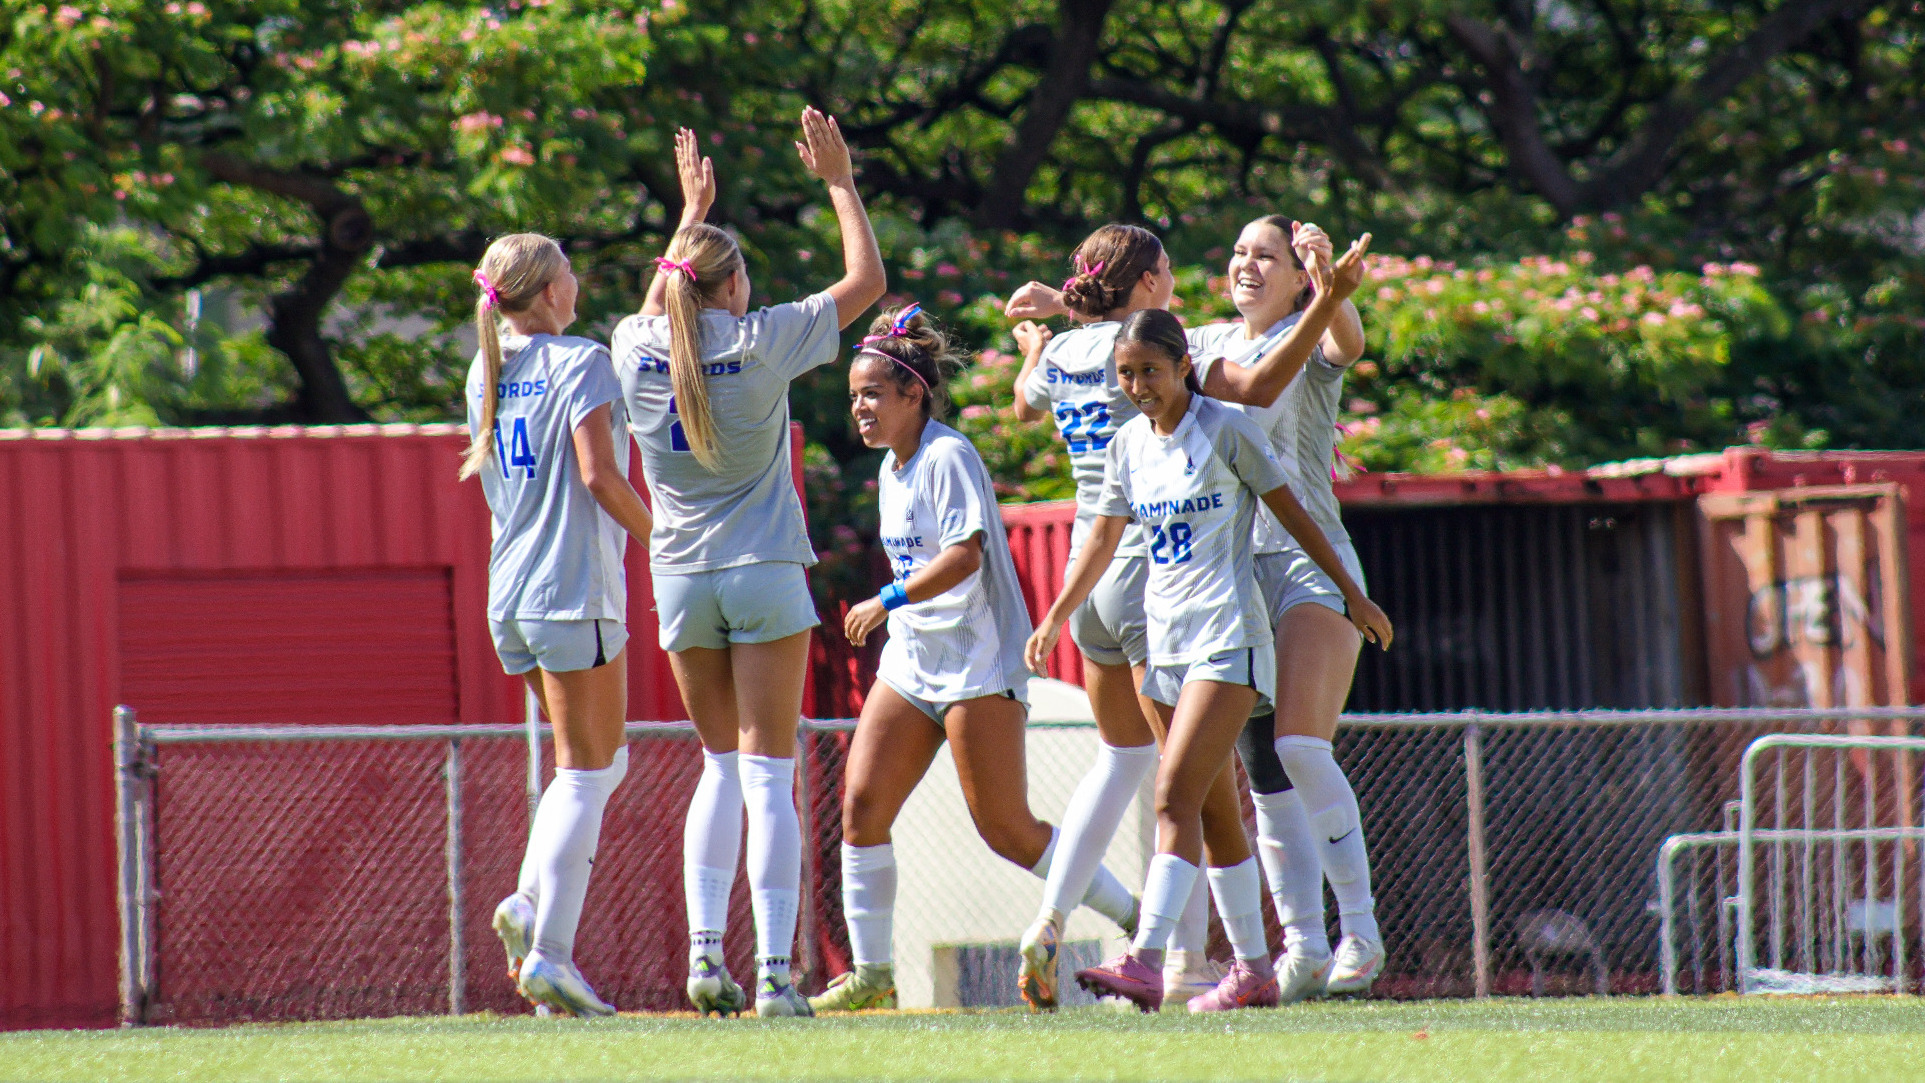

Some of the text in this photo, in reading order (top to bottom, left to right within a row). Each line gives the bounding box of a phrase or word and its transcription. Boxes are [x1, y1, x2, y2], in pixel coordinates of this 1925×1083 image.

[638, 356, 742, 376] SWDS
[478, 380, 546, 398] ORDS
[1056, 401, 1115, 453] 22
[494, 417, 537, 479] 14
[1130, 493, 1223, 518] AMINADE
[1151, 522, 1192, 565] 28
